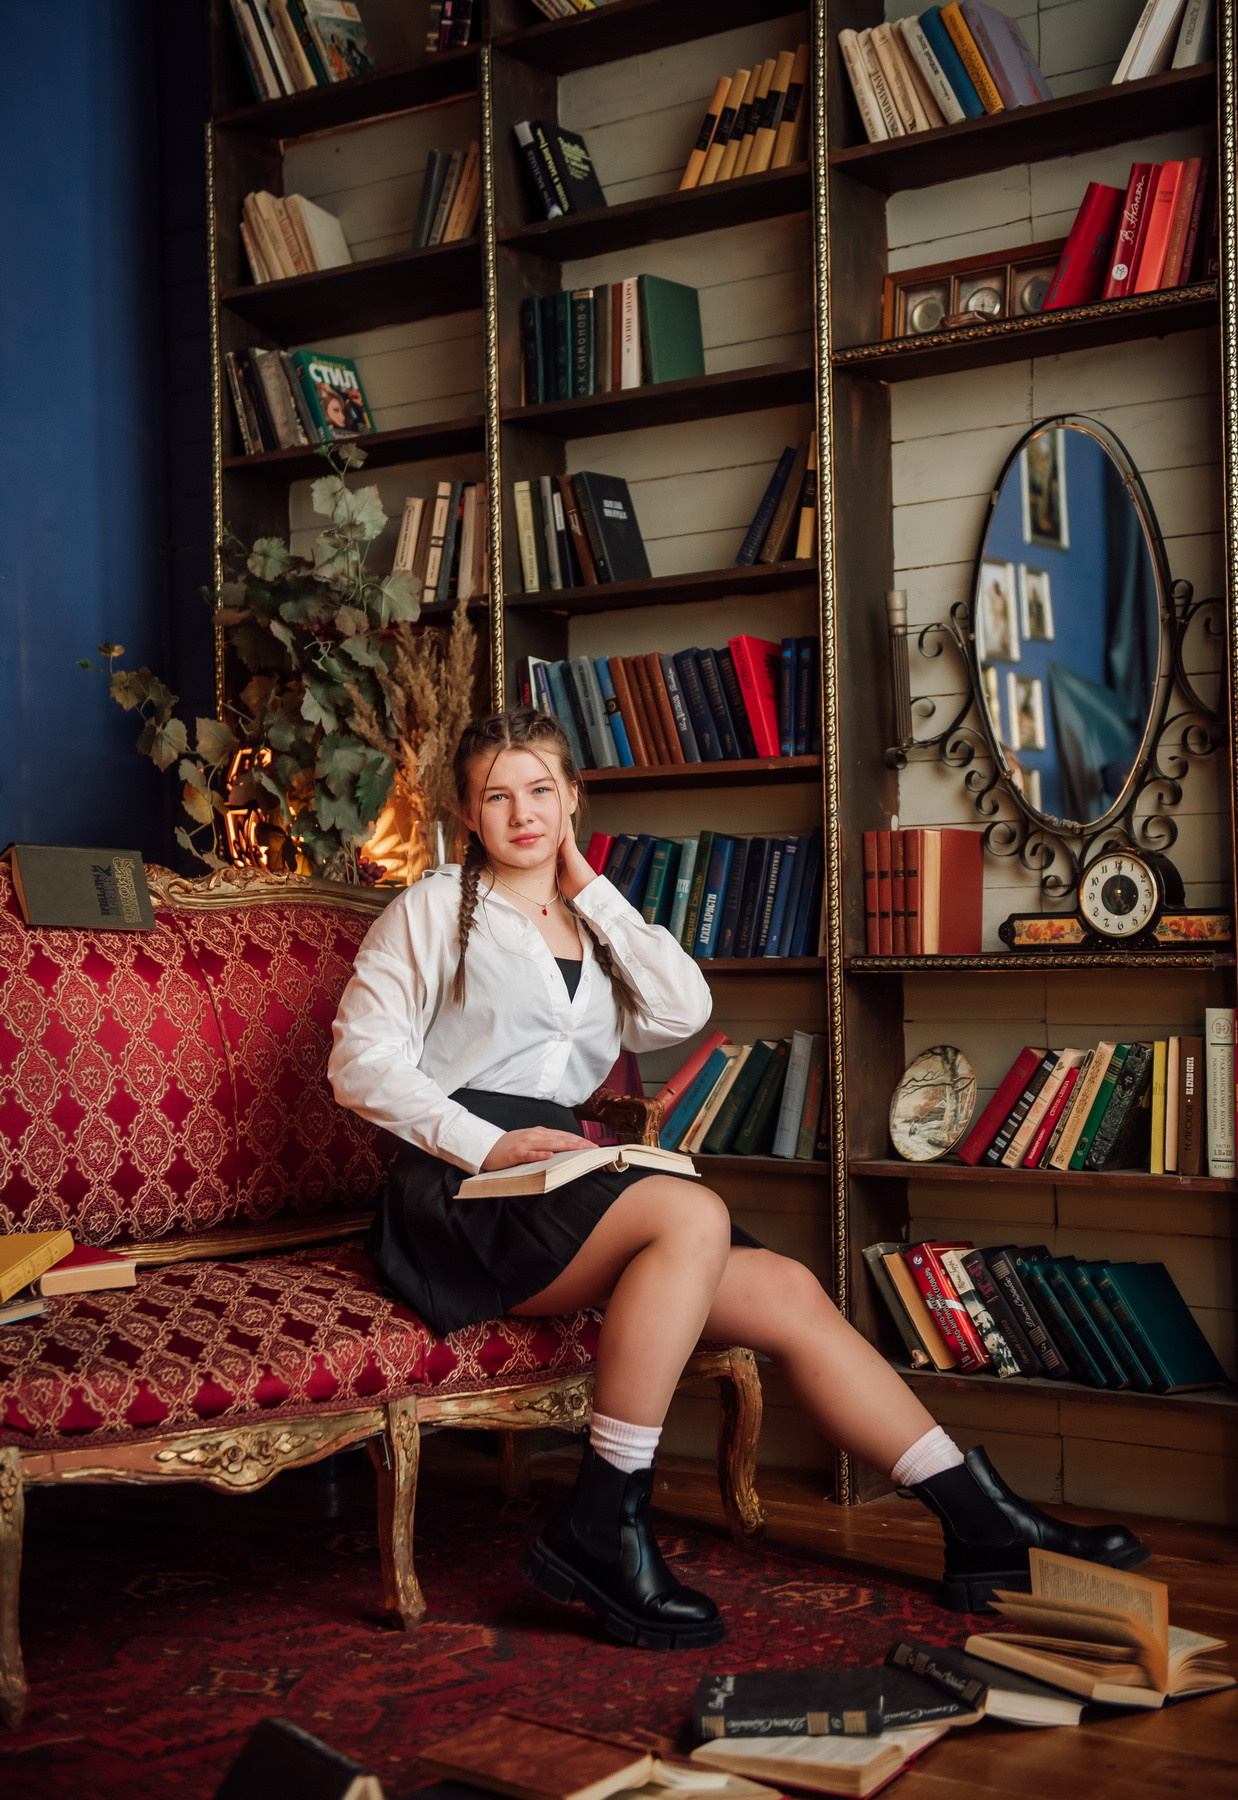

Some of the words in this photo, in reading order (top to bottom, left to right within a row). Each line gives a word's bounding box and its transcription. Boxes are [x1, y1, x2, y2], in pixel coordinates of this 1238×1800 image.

[576, 313, 586, 369] СИМОНОВ
[308, 362, 357, 390] СТИЛ
[767, 850, 781, 893] КИБЕРНЕТИКА
[1140, 873, 1146, 882] 2
[113, 856, 137, 924] СИМОНОВ
[1089, 893, 1095, 901] 9
[1144, 889, 1152, 898] 3
[702, 892, 717, 922] КРИСТИ
[1093, 907, 1099, 917] 8
[1140, 904, 1148, 914] 4
[1118, 921, 1124, 931] 6
[1132, 917, 1139, 926] 5
[698, 922, 712, 944] АГАТА
[1186, 1056, 1194, 1072] СВЕТА
[1185, 1072, 1194, 1087] КРАЮ
[1184, 1104, 1193, 1141] ЛЕСКОВ
[925, 1267, 941, 1295] СЛОВАРЬ
[926, 1291, 953, 1337] АНГЛО-РУССКИЙ
